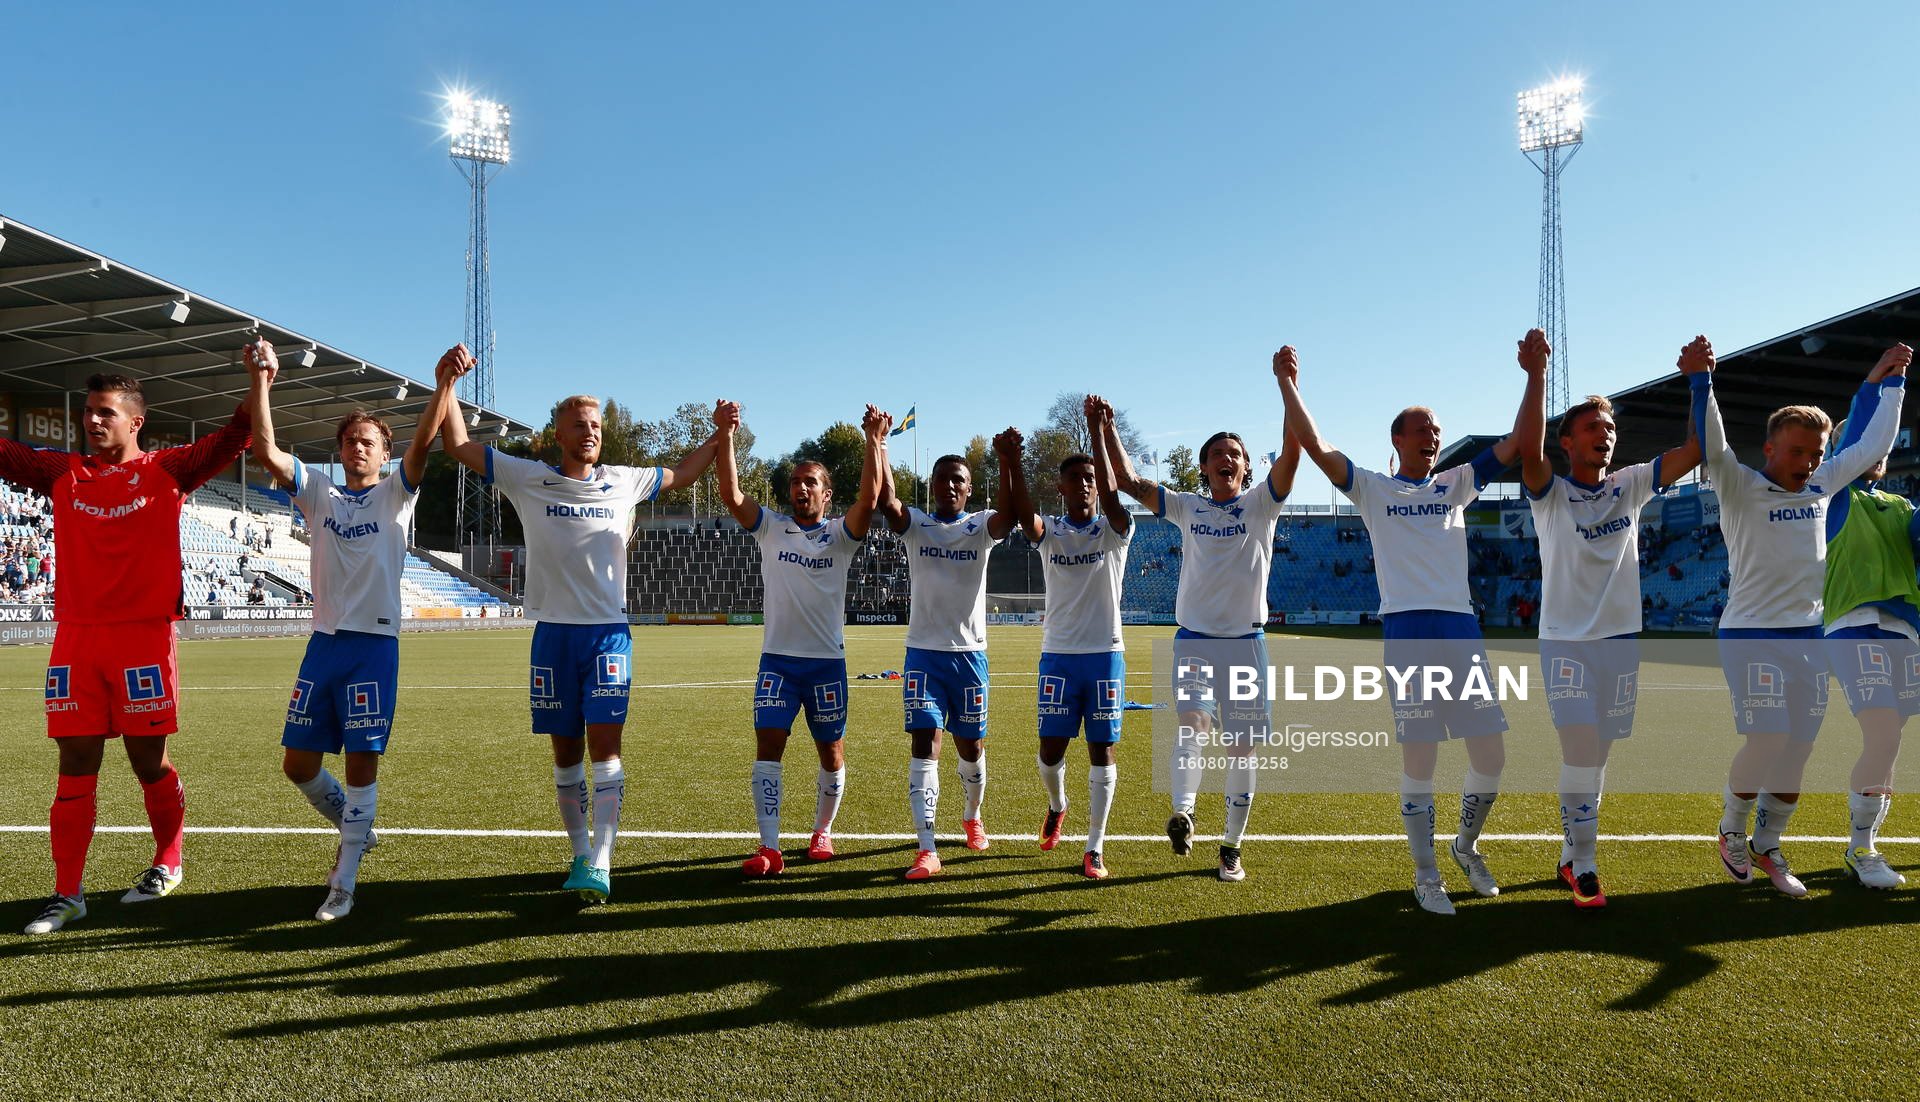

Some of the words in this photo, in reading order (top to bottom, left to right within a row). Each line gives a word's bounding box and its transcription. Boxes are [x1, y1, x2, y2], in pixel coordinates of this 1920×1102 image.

[73, 495, 147, 519] HOLMEN
[544, 505, 615, 519] HOLMEN
[1386, 503, 1452, 516] HOLMEN
[1190, 523, 1247, 537] HOLMEN
[778, 550, 833, 569] HOLMEN
[919, 546, 978, 561] HOLMEN
[1049, 550, 1105, 566] HOLMEN
[190, 607, 211, 620] kvm
[250, 608, 268, 620] GOLV
[269, 608, 275, 619] &
[856, 613, 897, 623] Inspecta
[2, 625, 34, 642] gillar
[194, 624, 205, 634] En
[206, 623, 241, 634] verkstad
[242, 622, 253, 633] för
[253, 624, 266, 633] oss
[267, 624, 282, 632] som
[282, 623, 300, 634] gillar
[1859, 687, 1875, 702] 17
[123, 699, 174, 714] stadium
[344, 717, 388, 730] stadium
[1745, 709, 1754, 725] 8
[1396, 720, 1406, 736] 4
